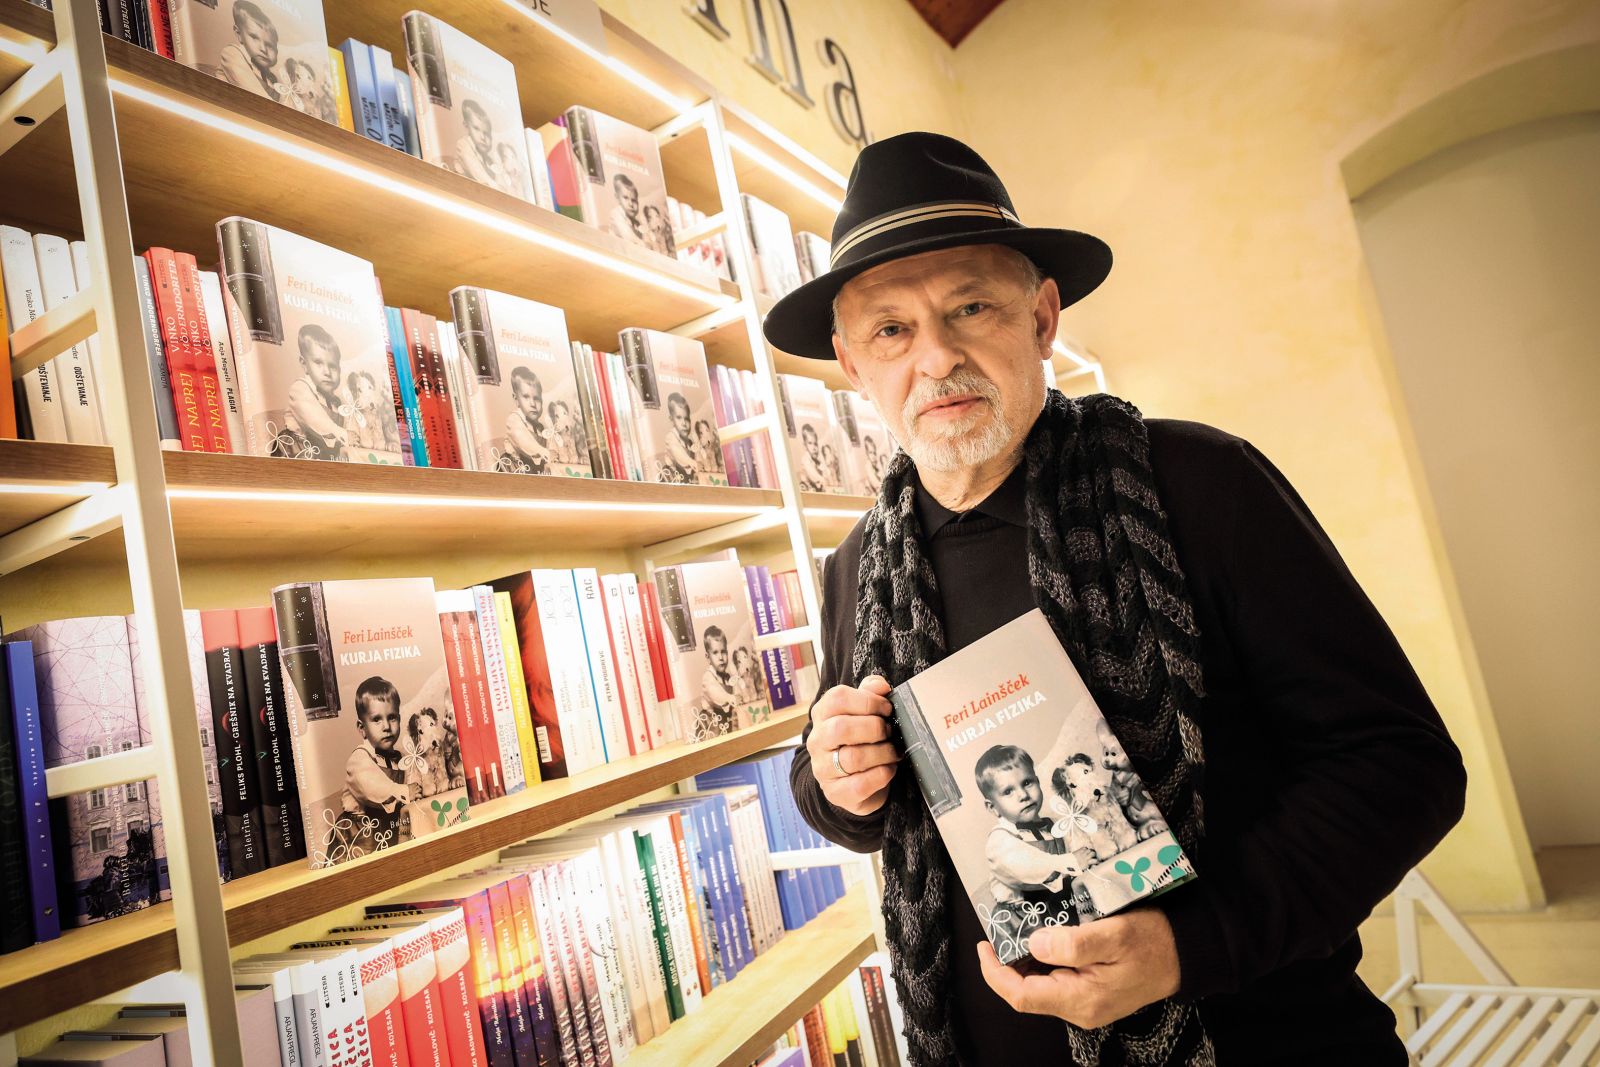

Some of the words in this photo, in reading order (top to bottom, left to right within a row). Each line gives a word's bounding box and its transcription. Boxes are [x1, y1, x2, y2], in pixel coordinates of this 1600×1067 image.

[168, 259, 191, 354] MÖDERNDORFER
[167, 317, 179, 352] VINKO
[190, 321, 202, 355] VINKO
[74, 366, 88, 406] ODŠTEVANJE
[180, 372, 200, 427] NAPREJ
[203, 375, 222, 428] NAPREJ
[226, 387, 237, 413] PLAGIAT
[343, 629, 364, 644] Feri
[366, 625, 413, 642] Lainšček
[222, 646, 233, 686] KVADRAT
[259, 643, 270, 682] KVADRAT
[340, 650, 383, 666] KURJA
[383, 645, 421, 661] FIZIKA
[228, 686, 235, 700] NA
[265, 682, 272, 695] NA
[287, 681, 296, 708] FIZIKA
[943, 709, 970, 729] Feri
[969, 674, 1030, 715] Lainšček
[228, 700, 240, 739] GREŠNIK
[267, 696, 277, 732] GREŠNIK
[292, 711, 300, 735] KURJA
[945, 719, 998, 752] KURJA
[998, 690, 1047, 726] FIZIKA
[234, 743, 243, 770] PLOHL
[273, 737, 281, 763] PLOHL
[238, 771, 247, 800] FELIKS
[276, 765, 284, 791] FELIKS
[115, 802, 123, 830] FRANCE
[282, 803, 291, 848] Beletrina
[245, 812, 253, 859] Beletrina
[120, 845, 131, 896] Beletrina
[545, 917, 558, 962] REZMAN
[560, 911, 574, 953] REZMAN
[575, 906, 590, 949] REZMAN
[553, 966, 565, 1000] PETER
[568, 955, 580, 992] PETER
[583, 951, 595, 985] PETER
[457, 970, 467, 1006] KOLESAR
[309, 1008, 319, 1033] ARJAN
[423, 988, 434, 1025] KOLESAR
[284, 1016, 294, 1041] ARJAN
[384, 1008, 395, 1047] KOLESAR
[463, 1010, 477, 1055] RADMILOVIČ
[313, 1033, 321, 1059] PREGL
